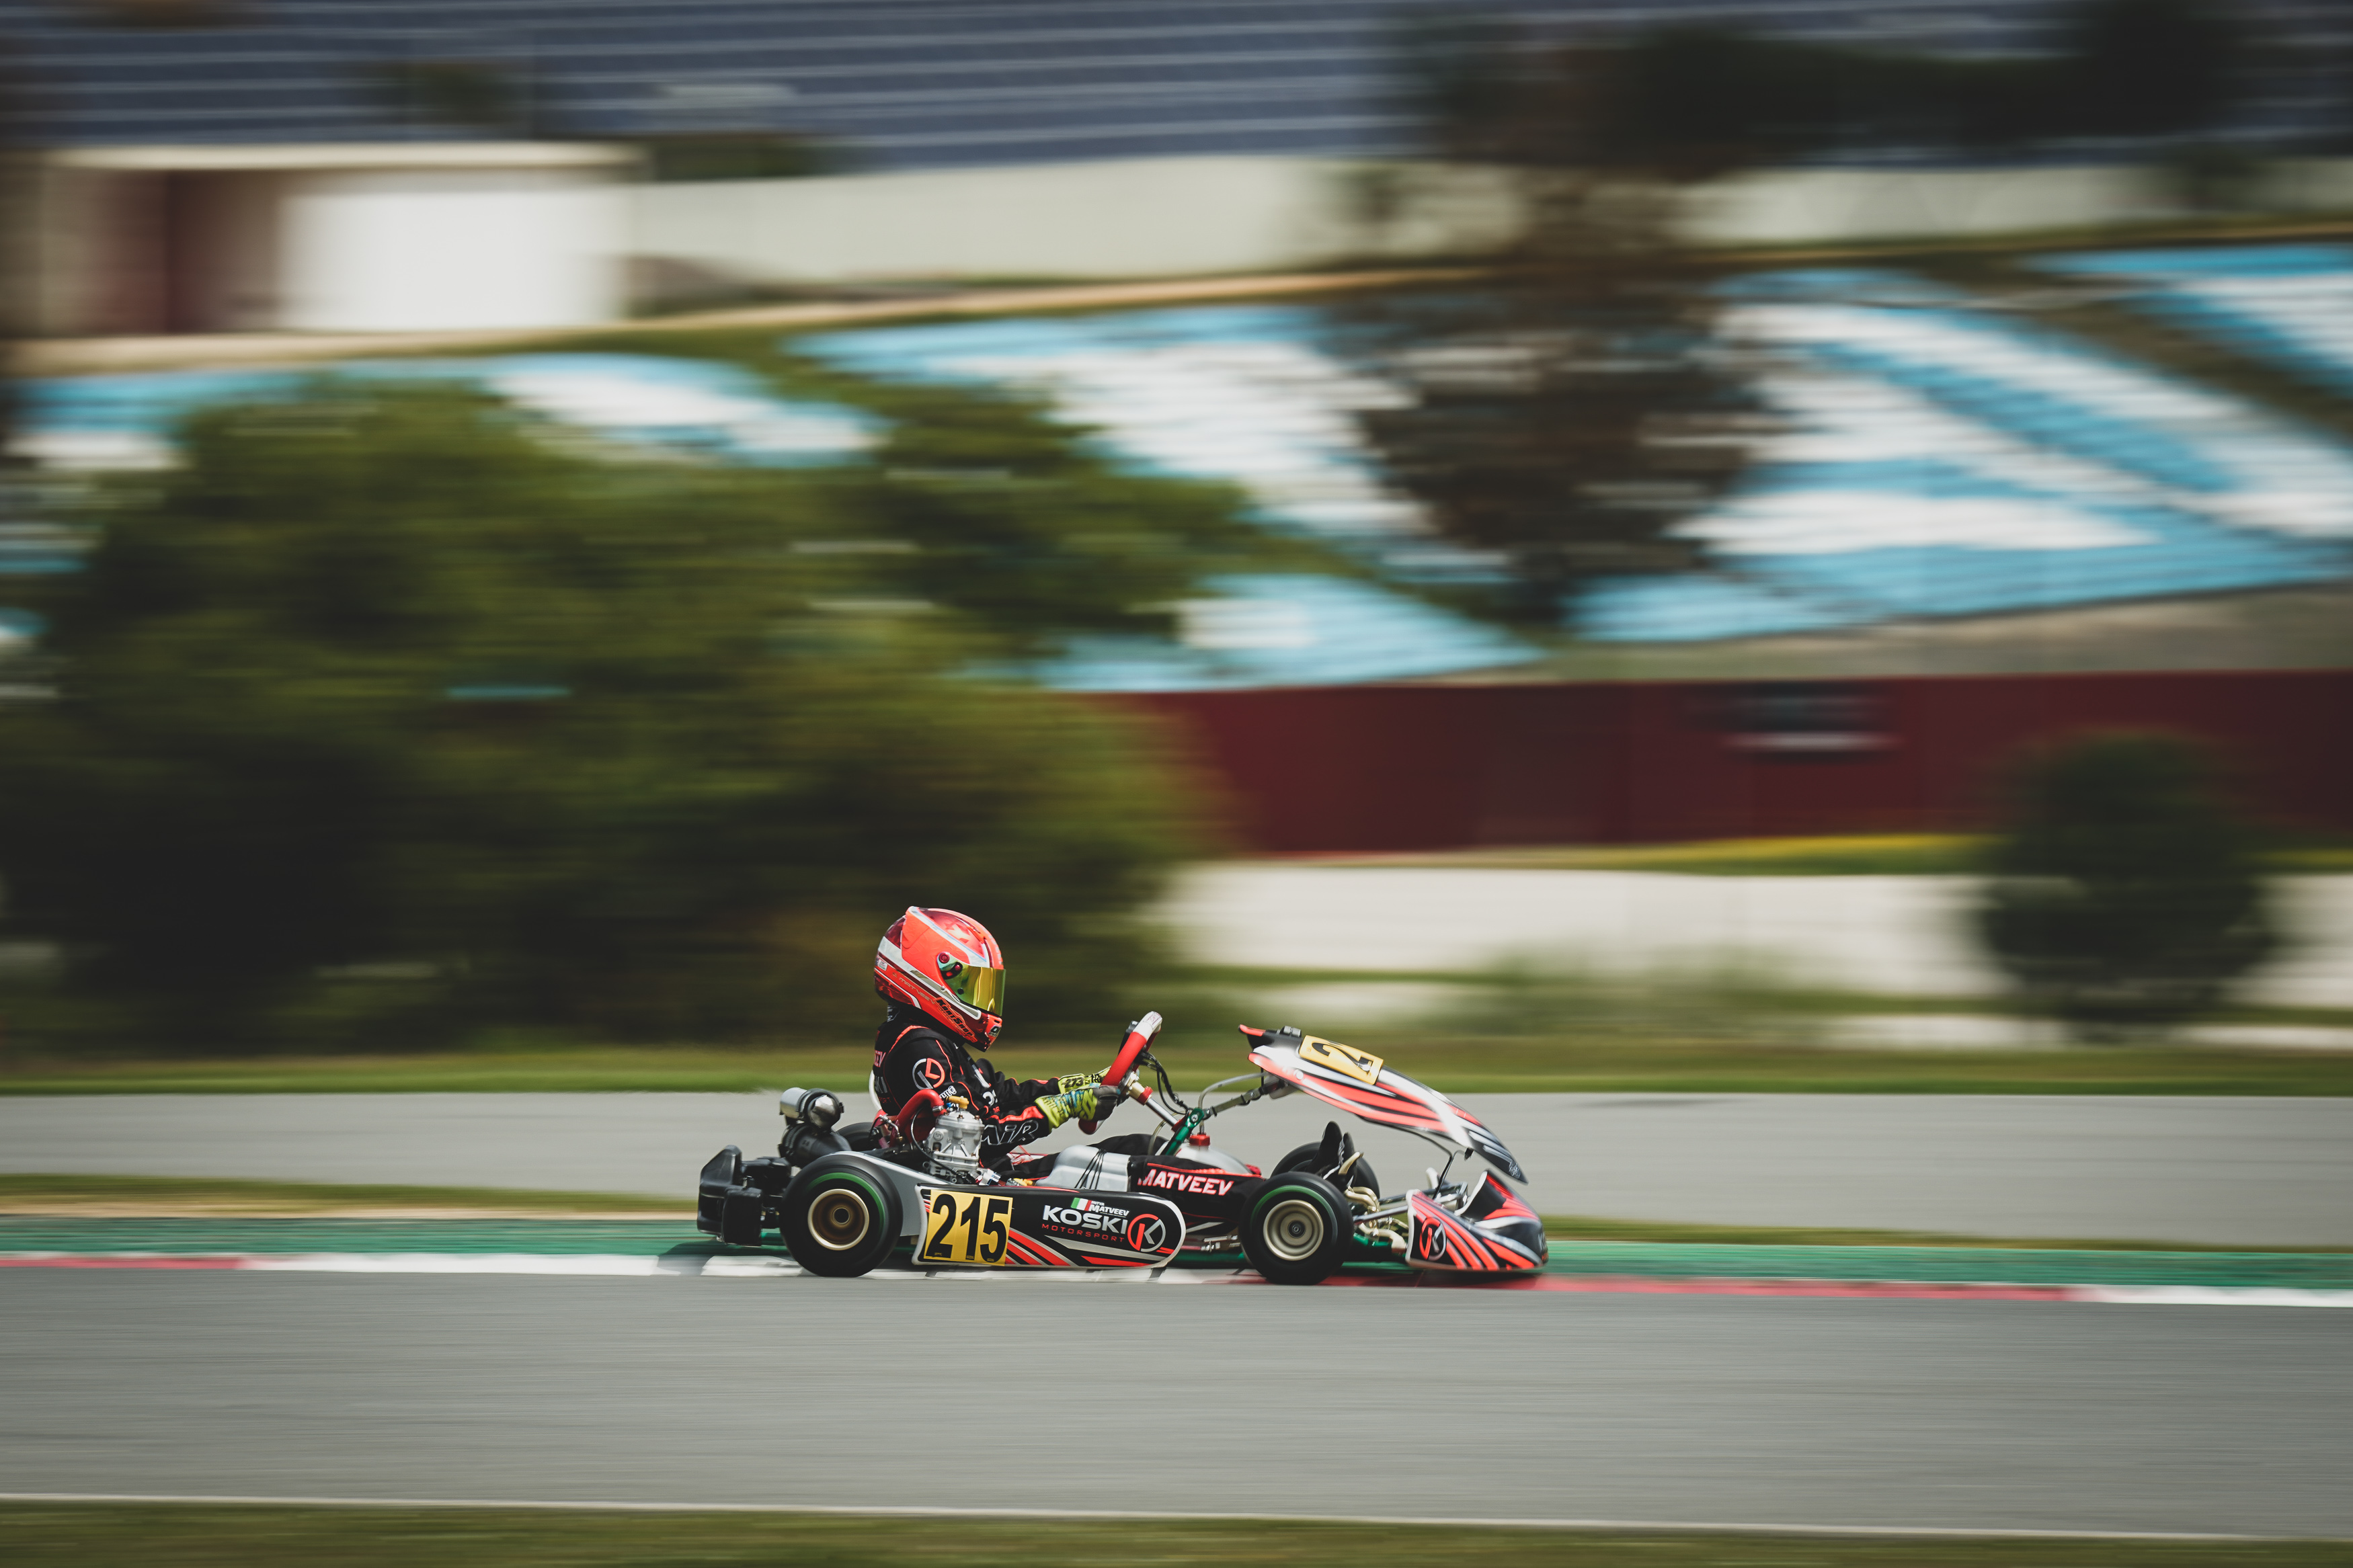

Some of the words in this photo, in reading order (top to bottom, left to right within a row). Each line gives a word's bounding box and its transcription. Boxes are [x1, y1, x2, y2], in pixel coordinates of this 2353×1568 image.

[1137, 1169, 1234, 1196] MATVEEV
[1042, 1205, 1128, 1234] KOSKI
[1088, 1204, 1129, 1216] MATVEEV
[926, 1194, 1009, 1263] 215
[1041, 1223, 1125, 1242] MOTORSPORT
